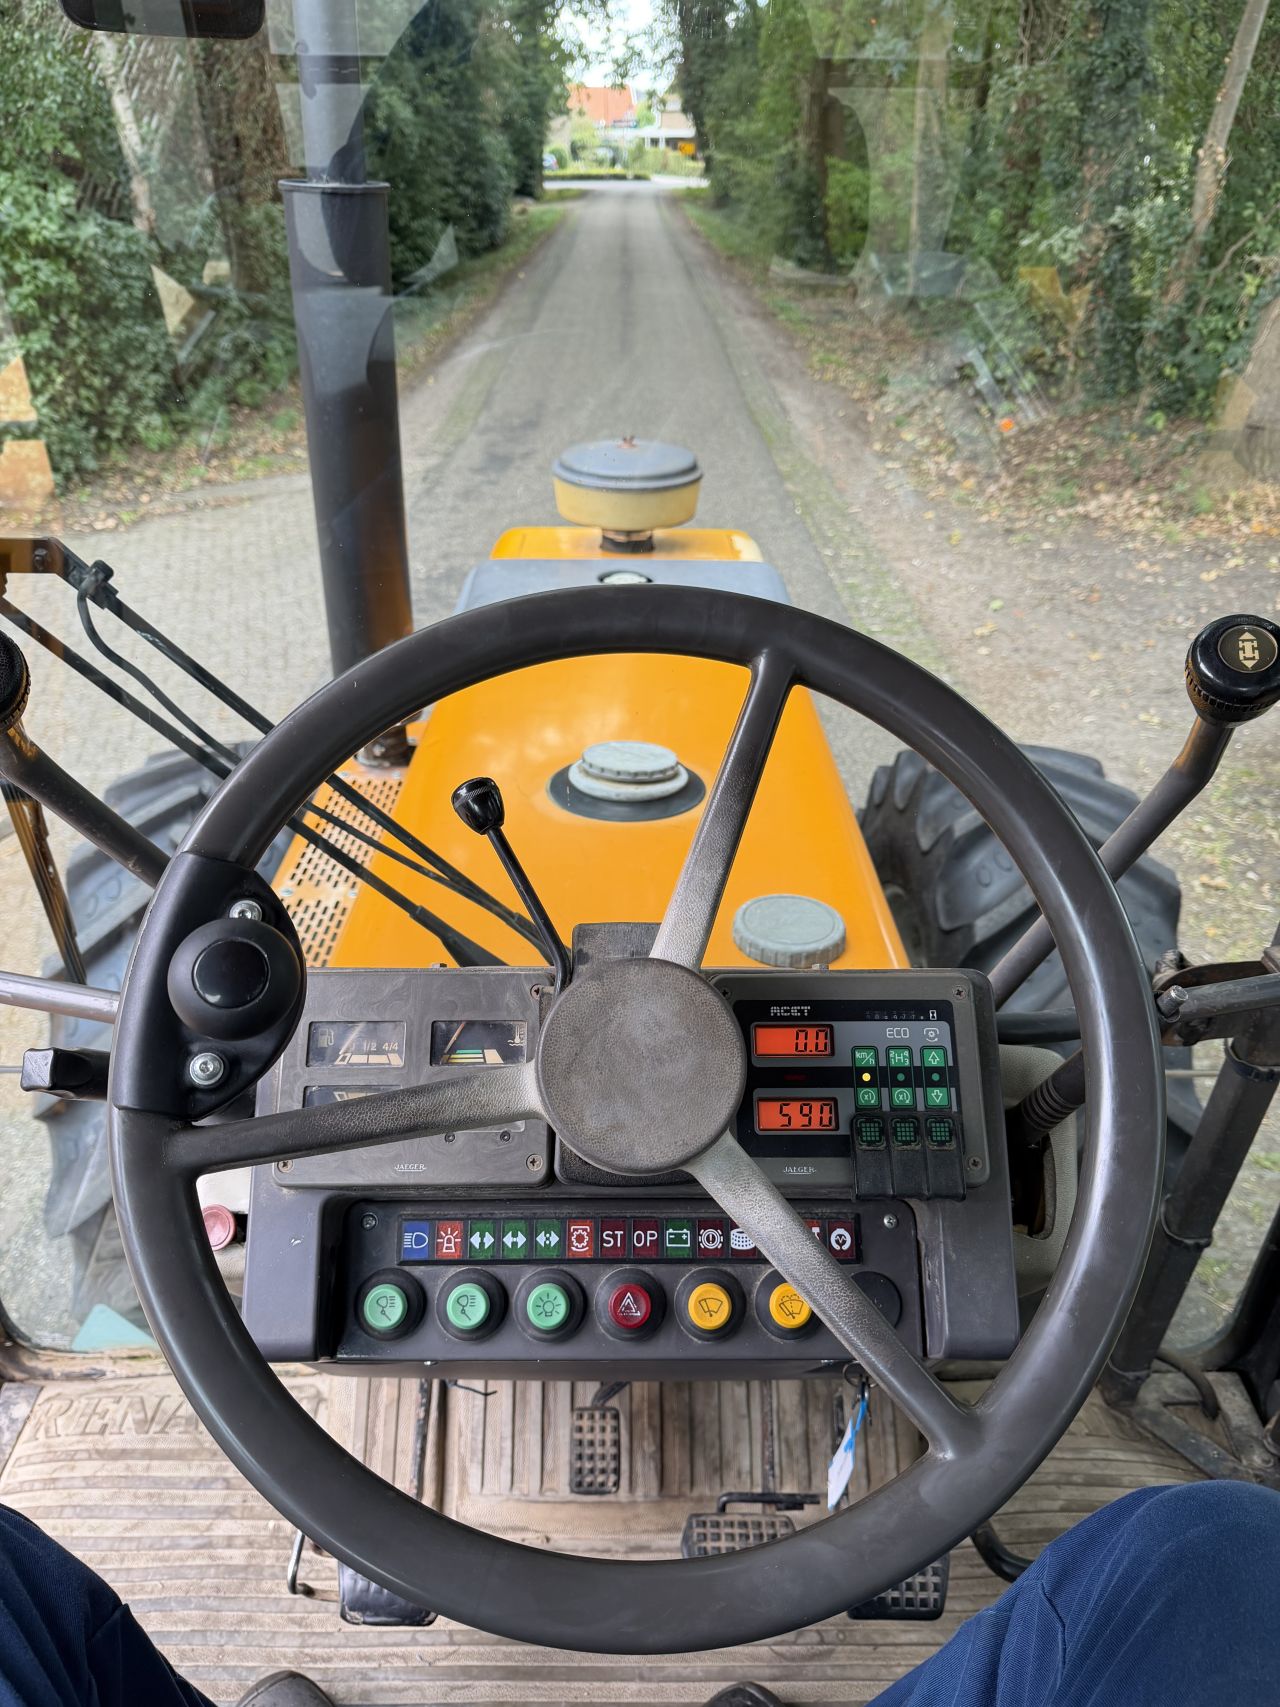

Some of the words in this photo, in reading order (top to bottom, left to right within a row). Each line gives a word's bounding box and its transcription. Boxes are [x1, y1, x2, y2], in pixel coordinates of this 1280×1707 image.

[770, 1005, 811, 1016] ACET
[886, 1027, 910, 1038] ECO
[363, 1040, 377, 1051] 1/2
[382, 1041, 399, 1051] 4/4
[795, 1029, 828, 1053] 0.0
[855, 1051, 875, 1065] km/h
[779, 1103, 833, 1128] 590
[394, 1163, 427, 1171] JAEGER
[783, 1166, 817, 1174] JAEGER
[602, 1230, 623, 1247] ST
[633, 1230, 659, 1247] OP
